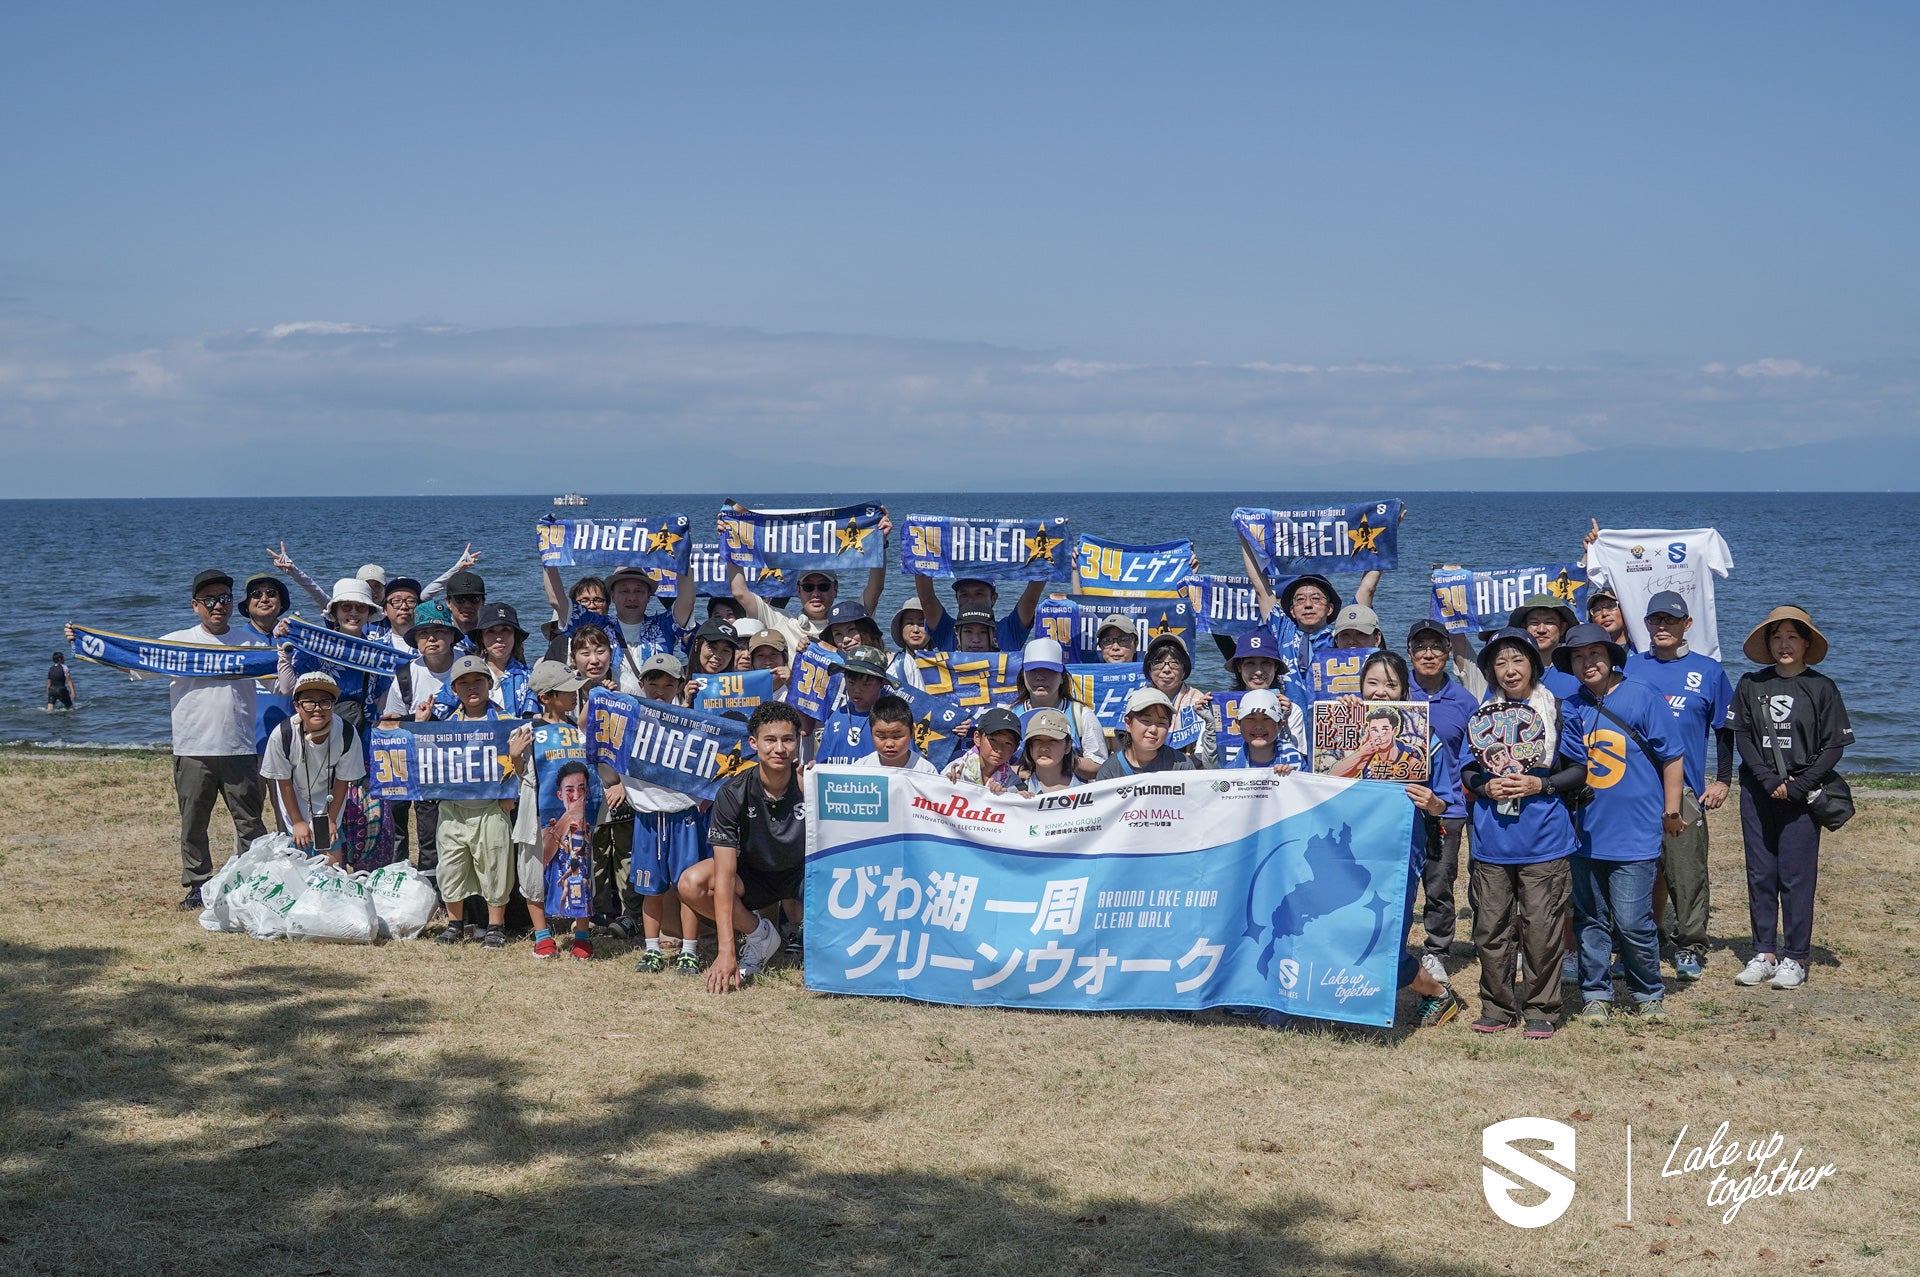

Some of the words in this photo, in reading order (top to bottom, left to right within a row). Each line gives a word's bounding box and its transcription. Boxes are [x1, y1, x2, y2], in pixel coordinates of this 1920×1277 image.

[537, 525, 565, 554] 34
[574, 524, 648, 552] HIGEN
[725, 520, 755, 550] 34
[764, 520, 837, 554] HIGEN
[908, 526, 942, 558] 34
[952, 526, 1026, 563] HIGEN
[1276, 521, 1350, 557] HIGEN
[1080, 542, 1124, 581] 34
[1122, 554, 1186, 583] ヒゲン
[1130, 606, 1147, 614] WORLD
[1436, 585, 1468, 618] 34
[1042, 617, 1072, 646] 34
[138, 646, 188, 673] SHIGA
[193, 654, 246, 676] LAKES
[298, 627, 345, 660] SHIGA
[349, 642, 398, 673] LAKES
[718, 674, 744, 697] 34
[798, 660, 830, 700] 34
[594, 697, 632, 712] HEIWADO
[704, 698, 723, 709] HIGEN
[725, 696, 761, 708] HASEGAWA
[1315, 704, 1366, 725] 長谷川
[594, 710, 628, 750] 34
[645, 706, 660, 719] FROM
[661, 710, 679, 724] SHIGA
[680, 717, 687, 726] TO
[689, 718, 700, 730] THE
[700, 722, 721, 736] WORLD
[1468, 708, 1544, 750] ヒゲン
[371, 737, 408, 746] HEIWADO
[420, 734, 435, 743] FROM
[436, 732, 454, 742] SHIGA
[454, 732, 462, 742] TO
[463, 732, 474, 741] THE
[474, 732, 494, 740] WORLD
[630, 720, 720, 779] HIGEN
[1315, 724, 1359, 749] 比源
[374, 748, 408, 783] 34
[418, 745, 498, 785] HIGEN
[1372, 760, 1427, 780] #34
[827, 782, 878, 794] Rethink
[1134, 782, 1185, 796] hummel
[827, 804, 880, 816] PROJECT
[912, 794, 1006, 824] muRata
[912, 812, 948, 826] INNOVATOR
[958, 823, 1002, 834] ELECTRONICS
[1044, 820, 1074, 830] KINKAN
[1076, 816, 1102, 826] GROUP
[1151, 809, 1184, 820] MALL
[636, 869, 650, 888] 11
[1097, 890, 1146, 908] AROUND
[1150, 890, 1182, 908] LAKE
[1185, 890, 1218, 908] BIWA
[1094, 912, 1134, 930] CLEAN
[1138, 910, 1172, 929] WALK
[845, 926, 1227, 995] クリーンウォーク
[1320, 967, 1350, 986] Lake
[1350, 974, 1364, 988] up
[1334, 980, 1381, 1004] together
